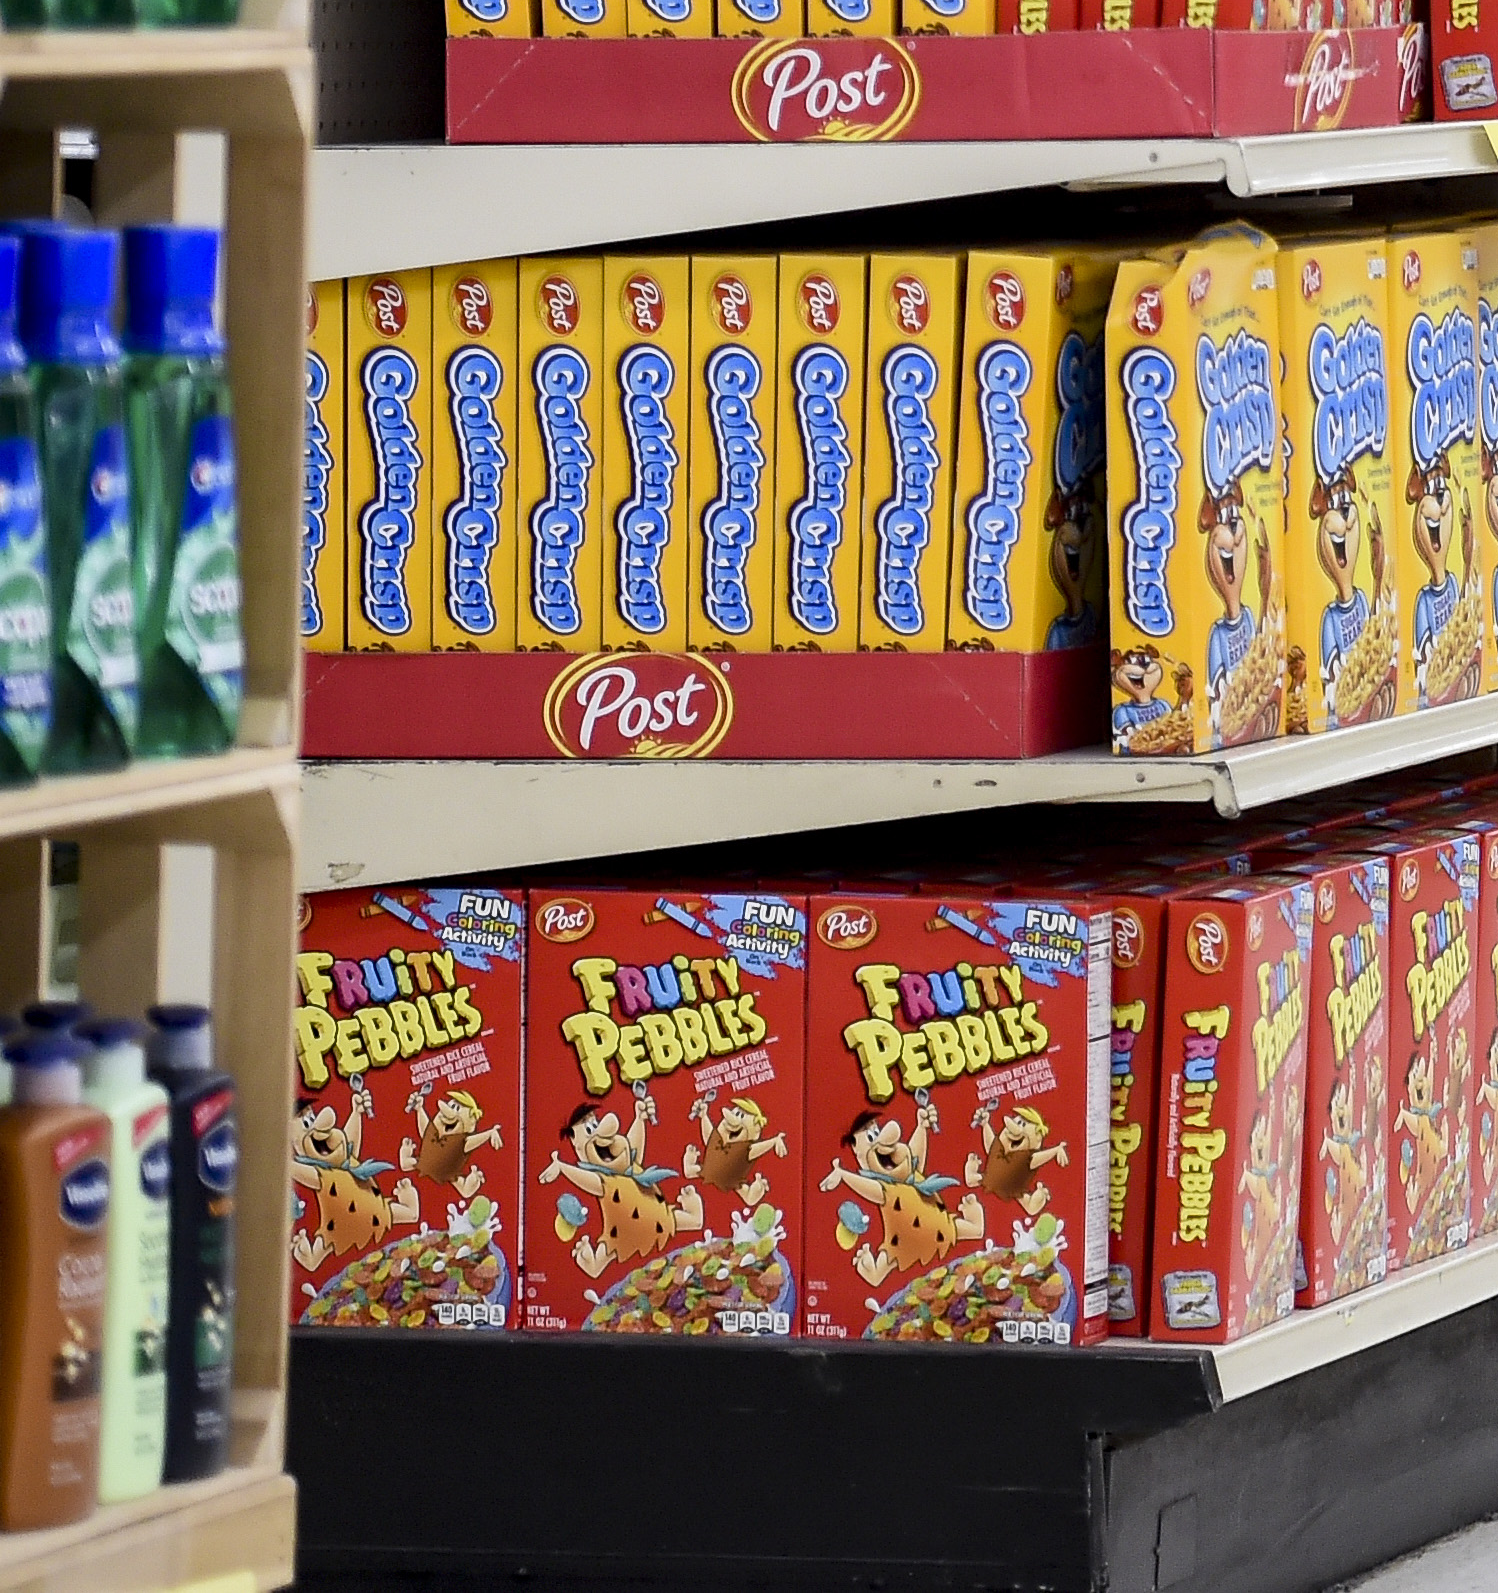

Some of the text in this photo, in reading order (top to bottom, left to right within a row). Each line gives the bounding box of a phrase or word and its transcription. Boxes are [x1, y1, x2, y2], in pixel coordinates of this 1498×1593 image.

[763, 49, 892, 132] Post
[372, 280, 402, 333] Post
[617, 343, 679, 510] Golden
[703, 343, 766, 510] Golden
[360, 344, 424, 634] Golden Crisp
[444, 343, 507, 633] Golden Crisp
[531, 343, 591, 633] Golden Crisp
[575, 665, 706, 751] Post
[446, 914, 517, 939] Coloring
[460, 895, 510, 919] FUN
[544, 905, 587, 934] Post
[730, 920, 802, 947] Coloring
[743, 900, 796, 926] FUN
[826, 908, 868, 939] Post
[1026, 909, 1077, 934] FUN
[442, 927, 505, 951] Activity
[725, 932, 791, 959] Activity
[1008, 941, 1072, 968] Activity
[1013, 928, 1084, 955] Coloring
[298, 949, 456, 1009] FRUITY
[572, 955, 740, 1017] FRUITY
[855, 962, 1023, 1024] FRUITY
[297, 984, 484, 1089] PEBBLES
[561, 991, 768, 1098] PEBBLES
[843, 1001, 1050, 1104] PEBBLES
[1178, 1004, 1231, 1244] FRUITY PEBBLES
